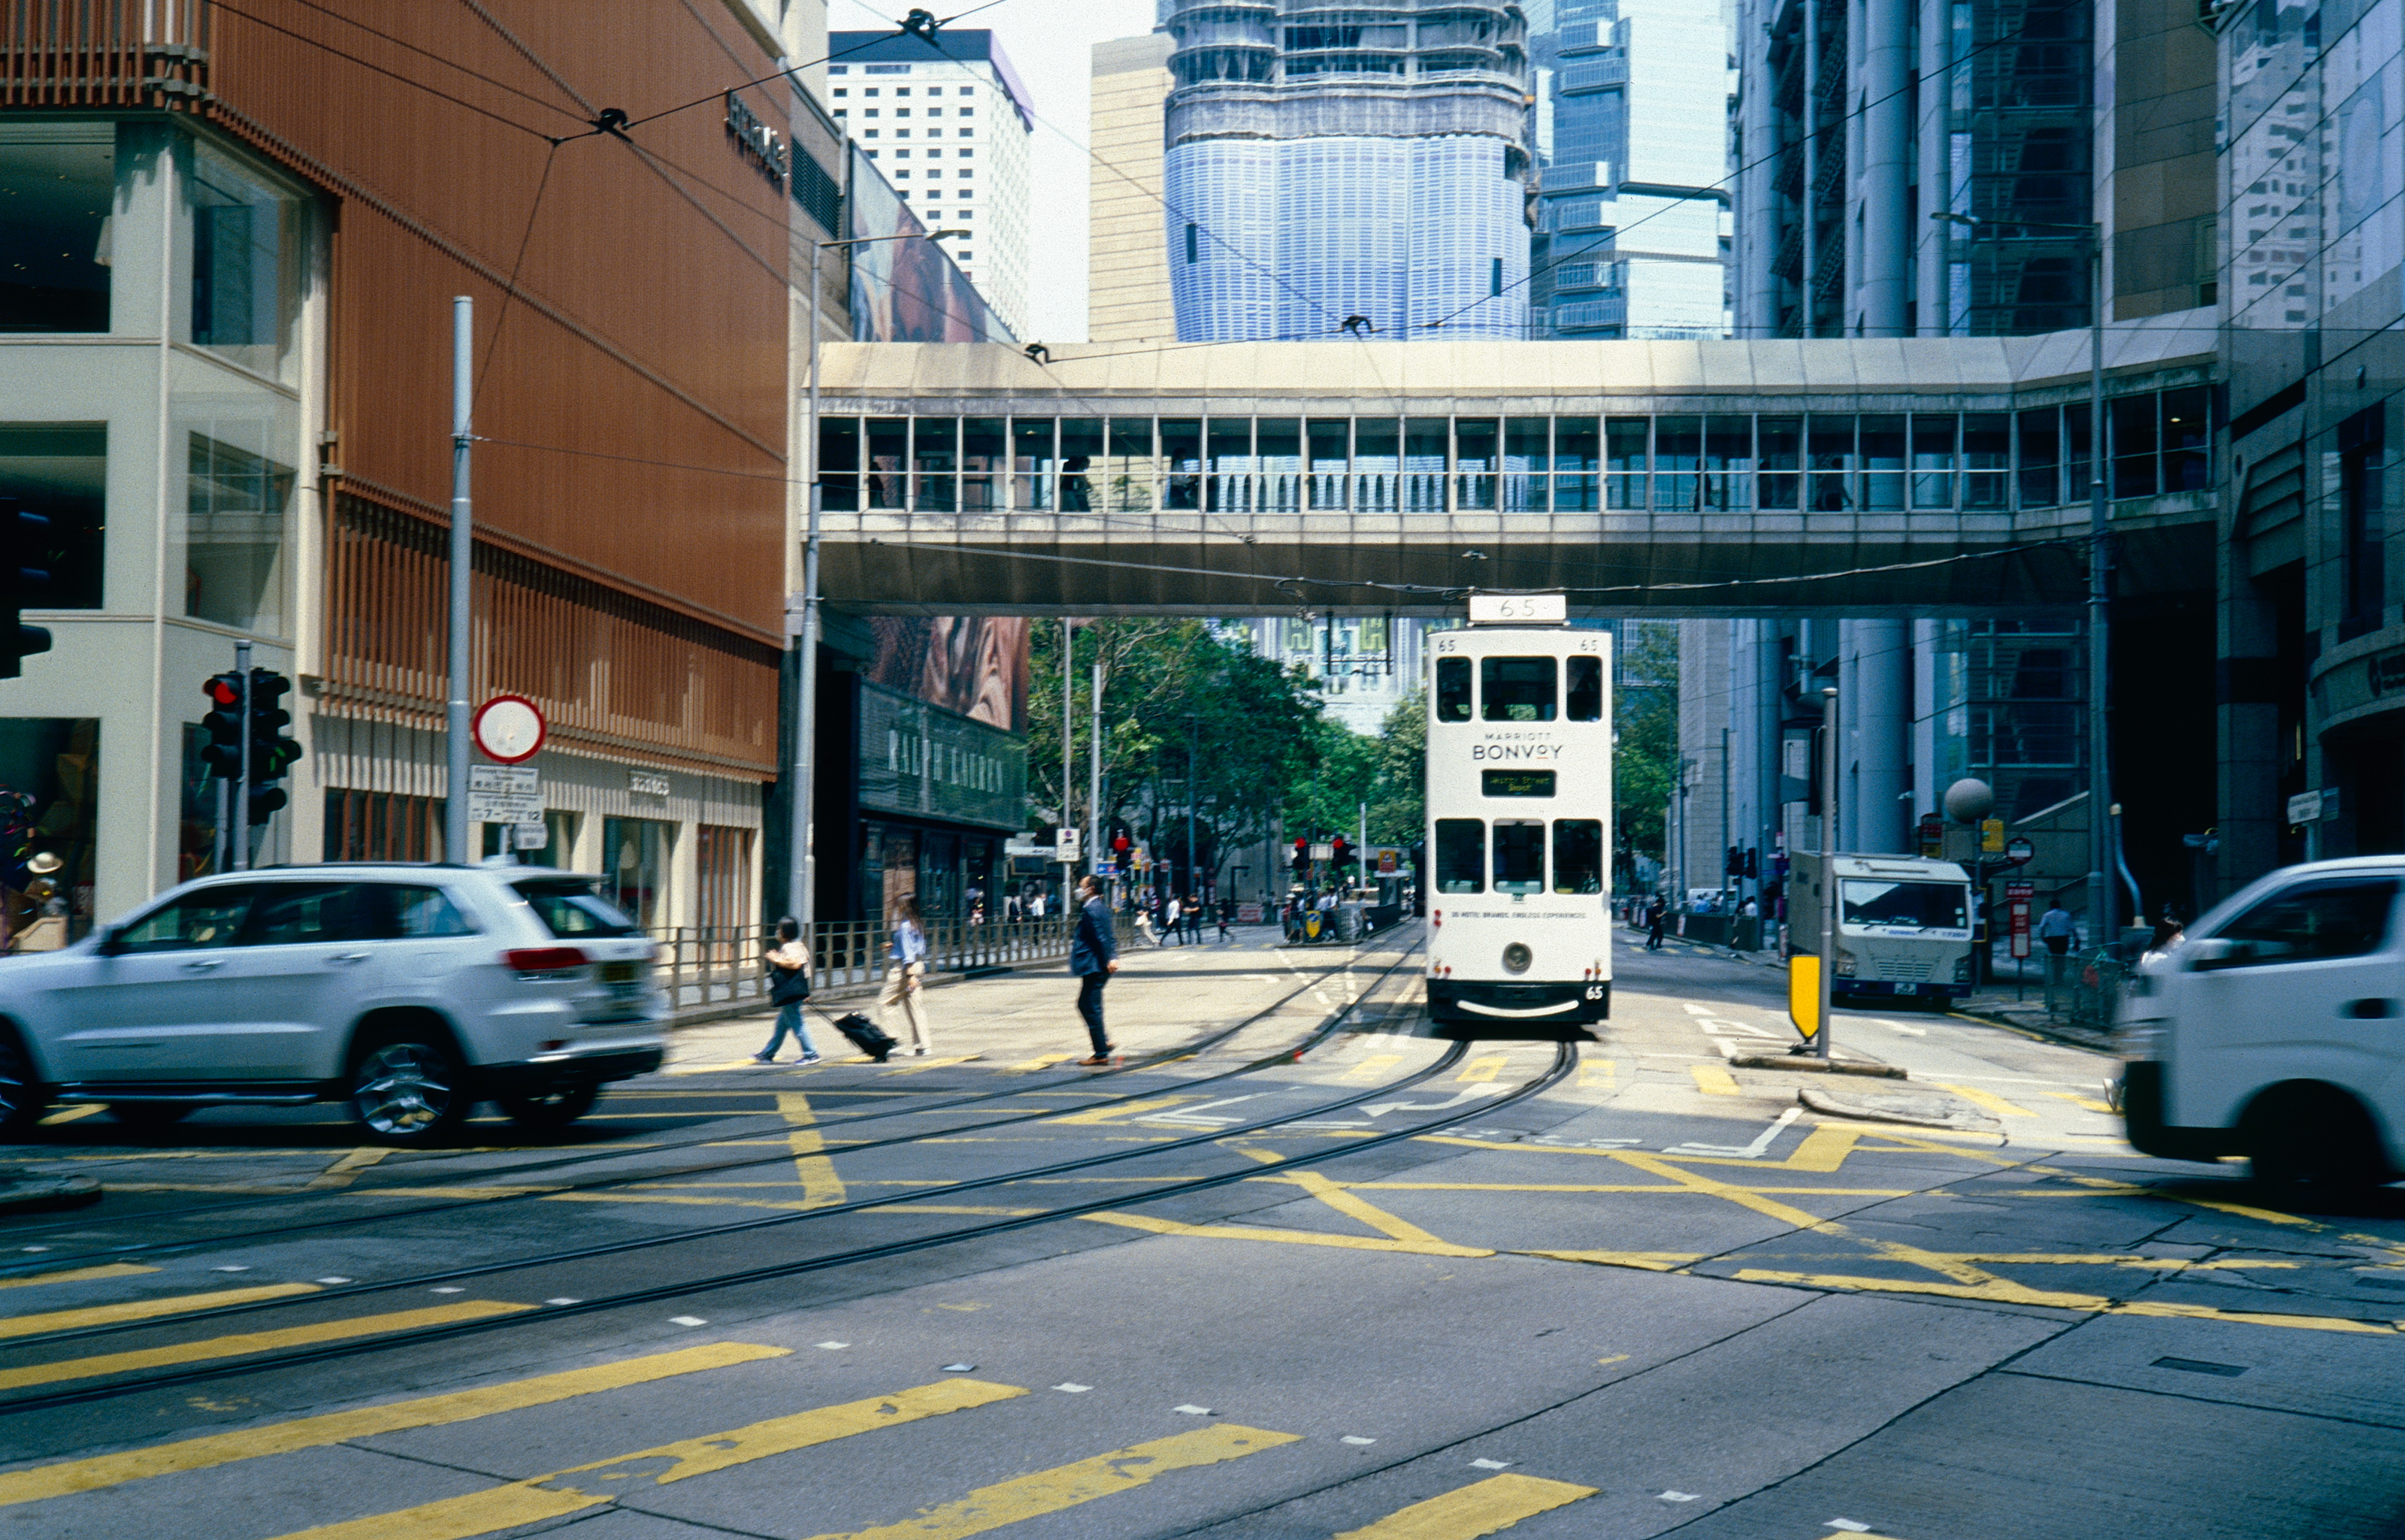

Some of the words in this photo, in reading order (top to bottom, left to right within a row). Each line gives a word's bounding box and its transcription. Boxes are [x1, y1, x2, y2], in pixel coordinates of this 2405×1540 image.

[1500, 600, 1535, 617] 65
[1438, 640, 1456, 652] 65
[1581, 640, 1599, 652] 65
[1485, 732, 1550, 741] MARRIOTT
[1473, 745, 1563, 760] BONVOY
[1587, 985, 1604, 1000] 65
